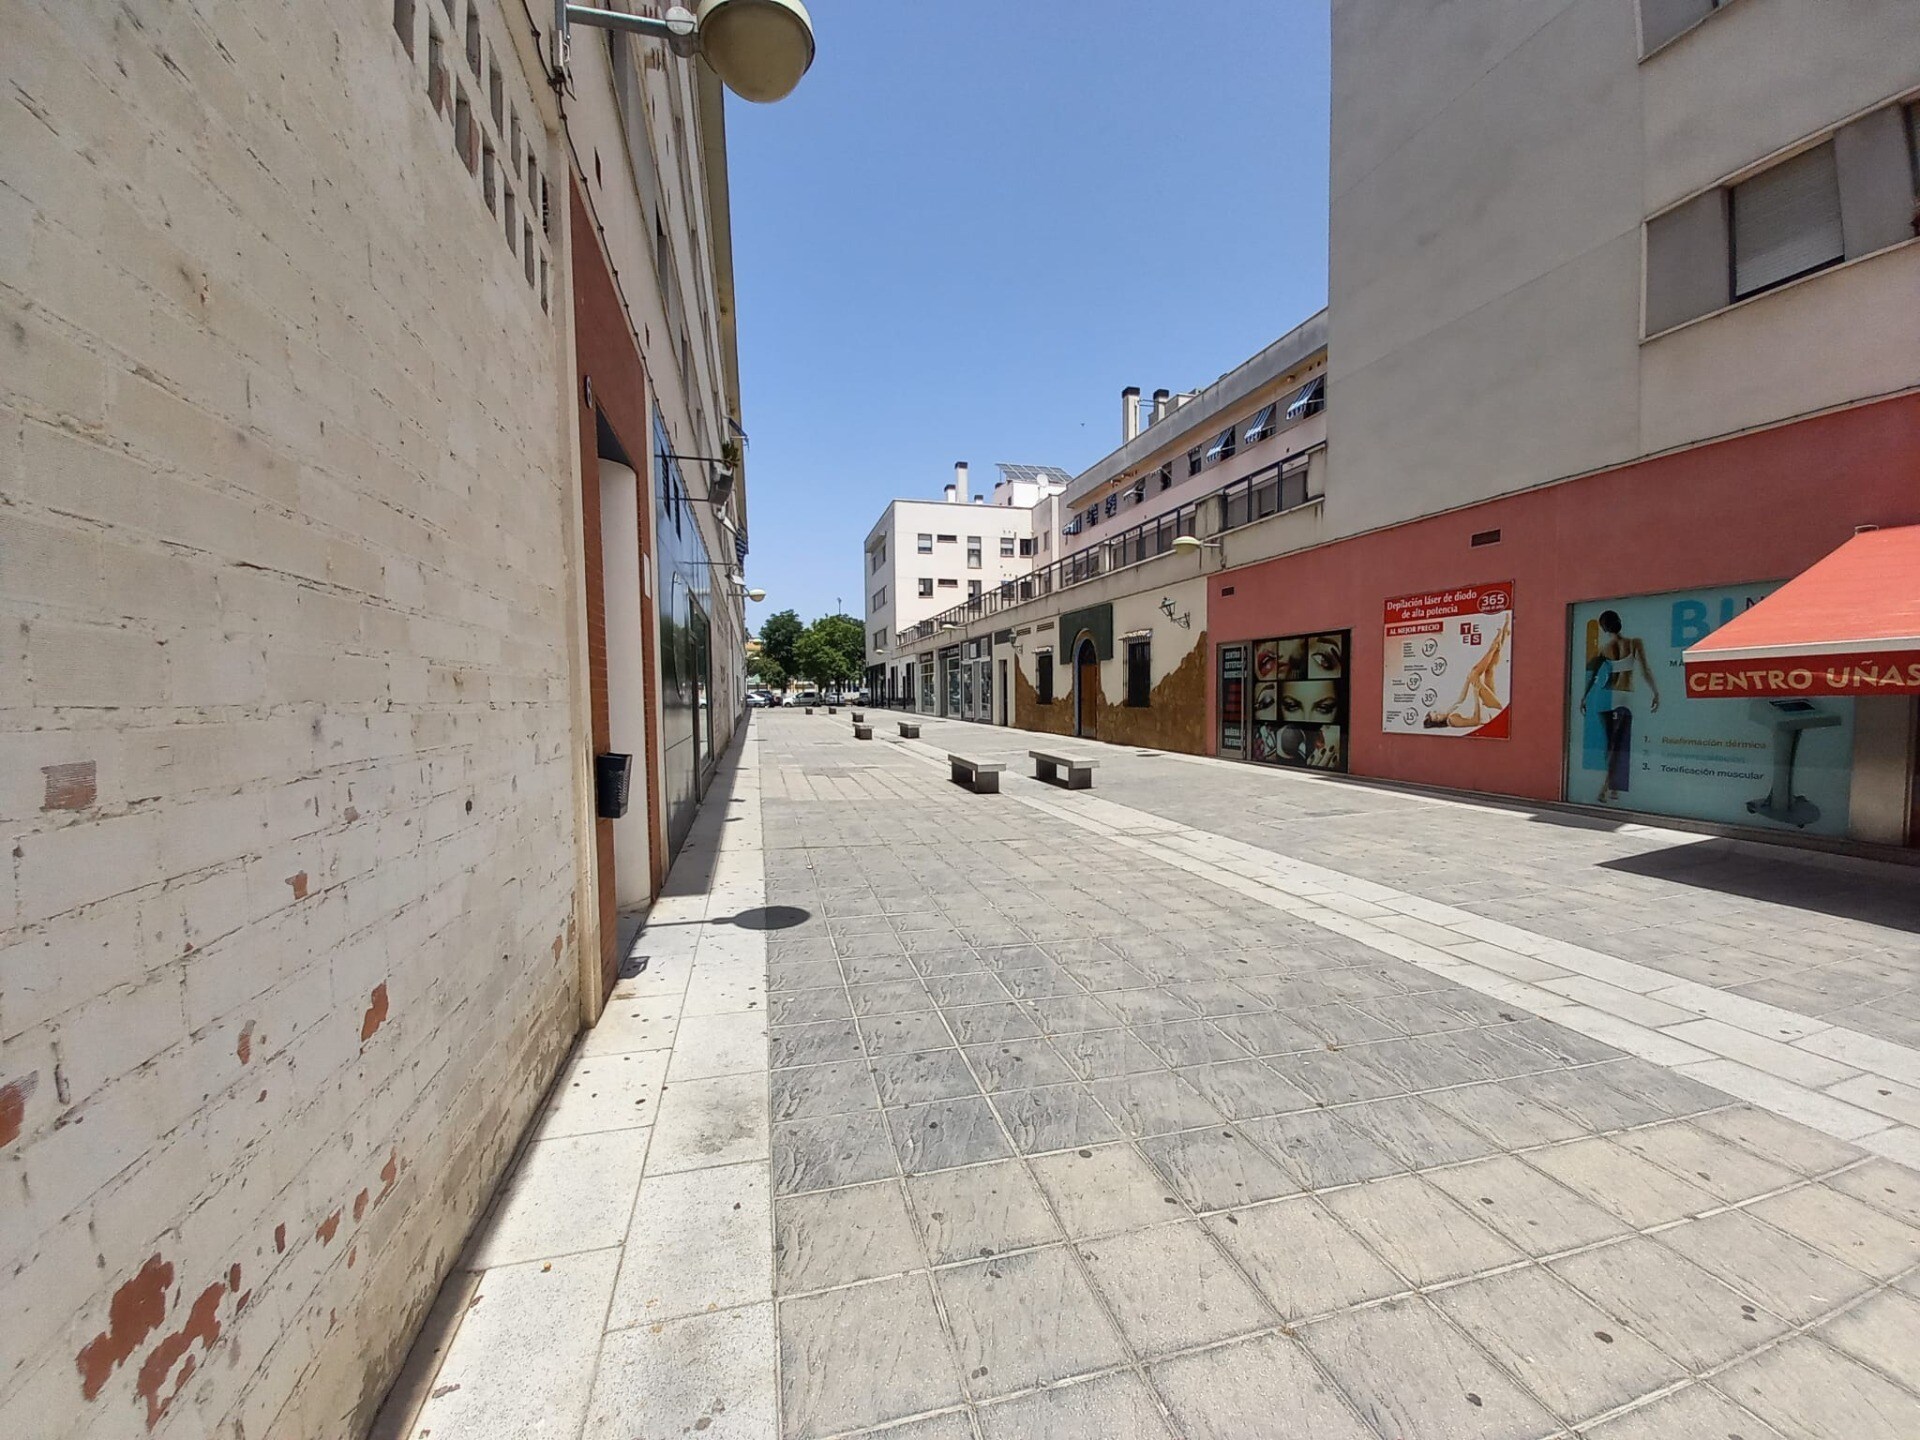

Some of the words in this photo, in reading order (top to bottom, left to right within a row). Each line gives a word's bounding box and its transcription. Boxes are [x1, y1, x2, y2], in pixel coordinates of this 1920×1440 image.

[1387, 598, 1422, 611] Depilación
[1424, 595, 1441, 605] láser
[1443, 593, 1453, 603] de
[1454, 589, 1477, 601] diodo
[1481, 593, 1505, 606] 365
[1401, 610, 1411, 619] de
[1411, 607, 1424, 617] alta
[1426, 603, 1458, 618] potencia
[1398, 626, 1416, 634] MEJOR
[1417, 624, 1440, 632] PRECIO
[1689, 668, 1813, 691] CENTRO
[1826, 660, 1920, 688] UÑAS
[1726, 738, 1767, 750] dérmica
[1660, 764, 1715, 776] Tonificación
[1717, 770, 1765, 780] muscular
